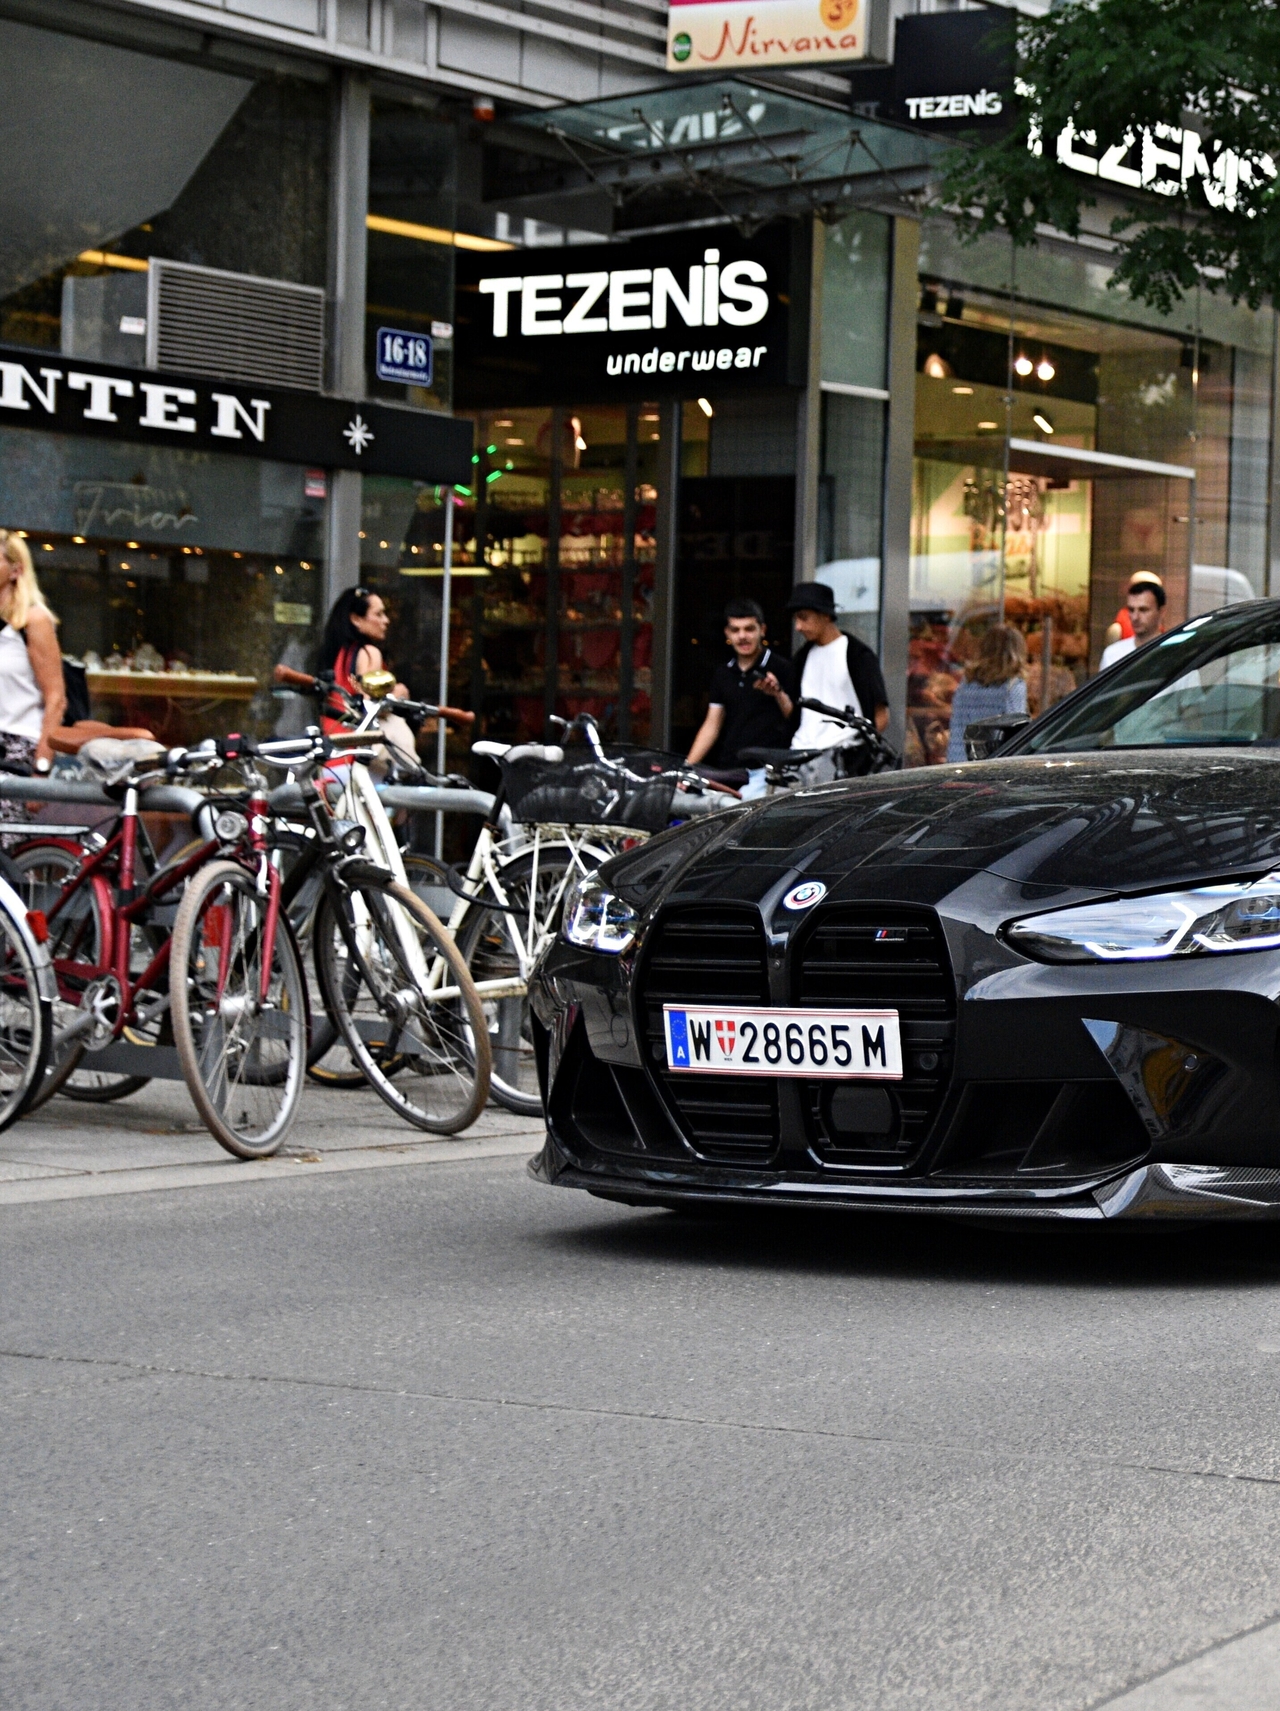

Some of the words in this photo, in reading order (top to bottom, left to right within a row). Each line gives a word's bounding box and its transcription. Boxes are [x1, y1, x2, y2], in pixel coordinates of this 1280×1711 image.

[698, 16, 857, 62] Nirvana
[384, 335, 428, 369] 16-18
[606, 346, 767, 376] underwear
[676, 1046, 686, 1060] A
[690, 1019, 711, 1061] W
[739, 1021, 853, 1067] 28665
[861, 1025, 887, 1067] M
